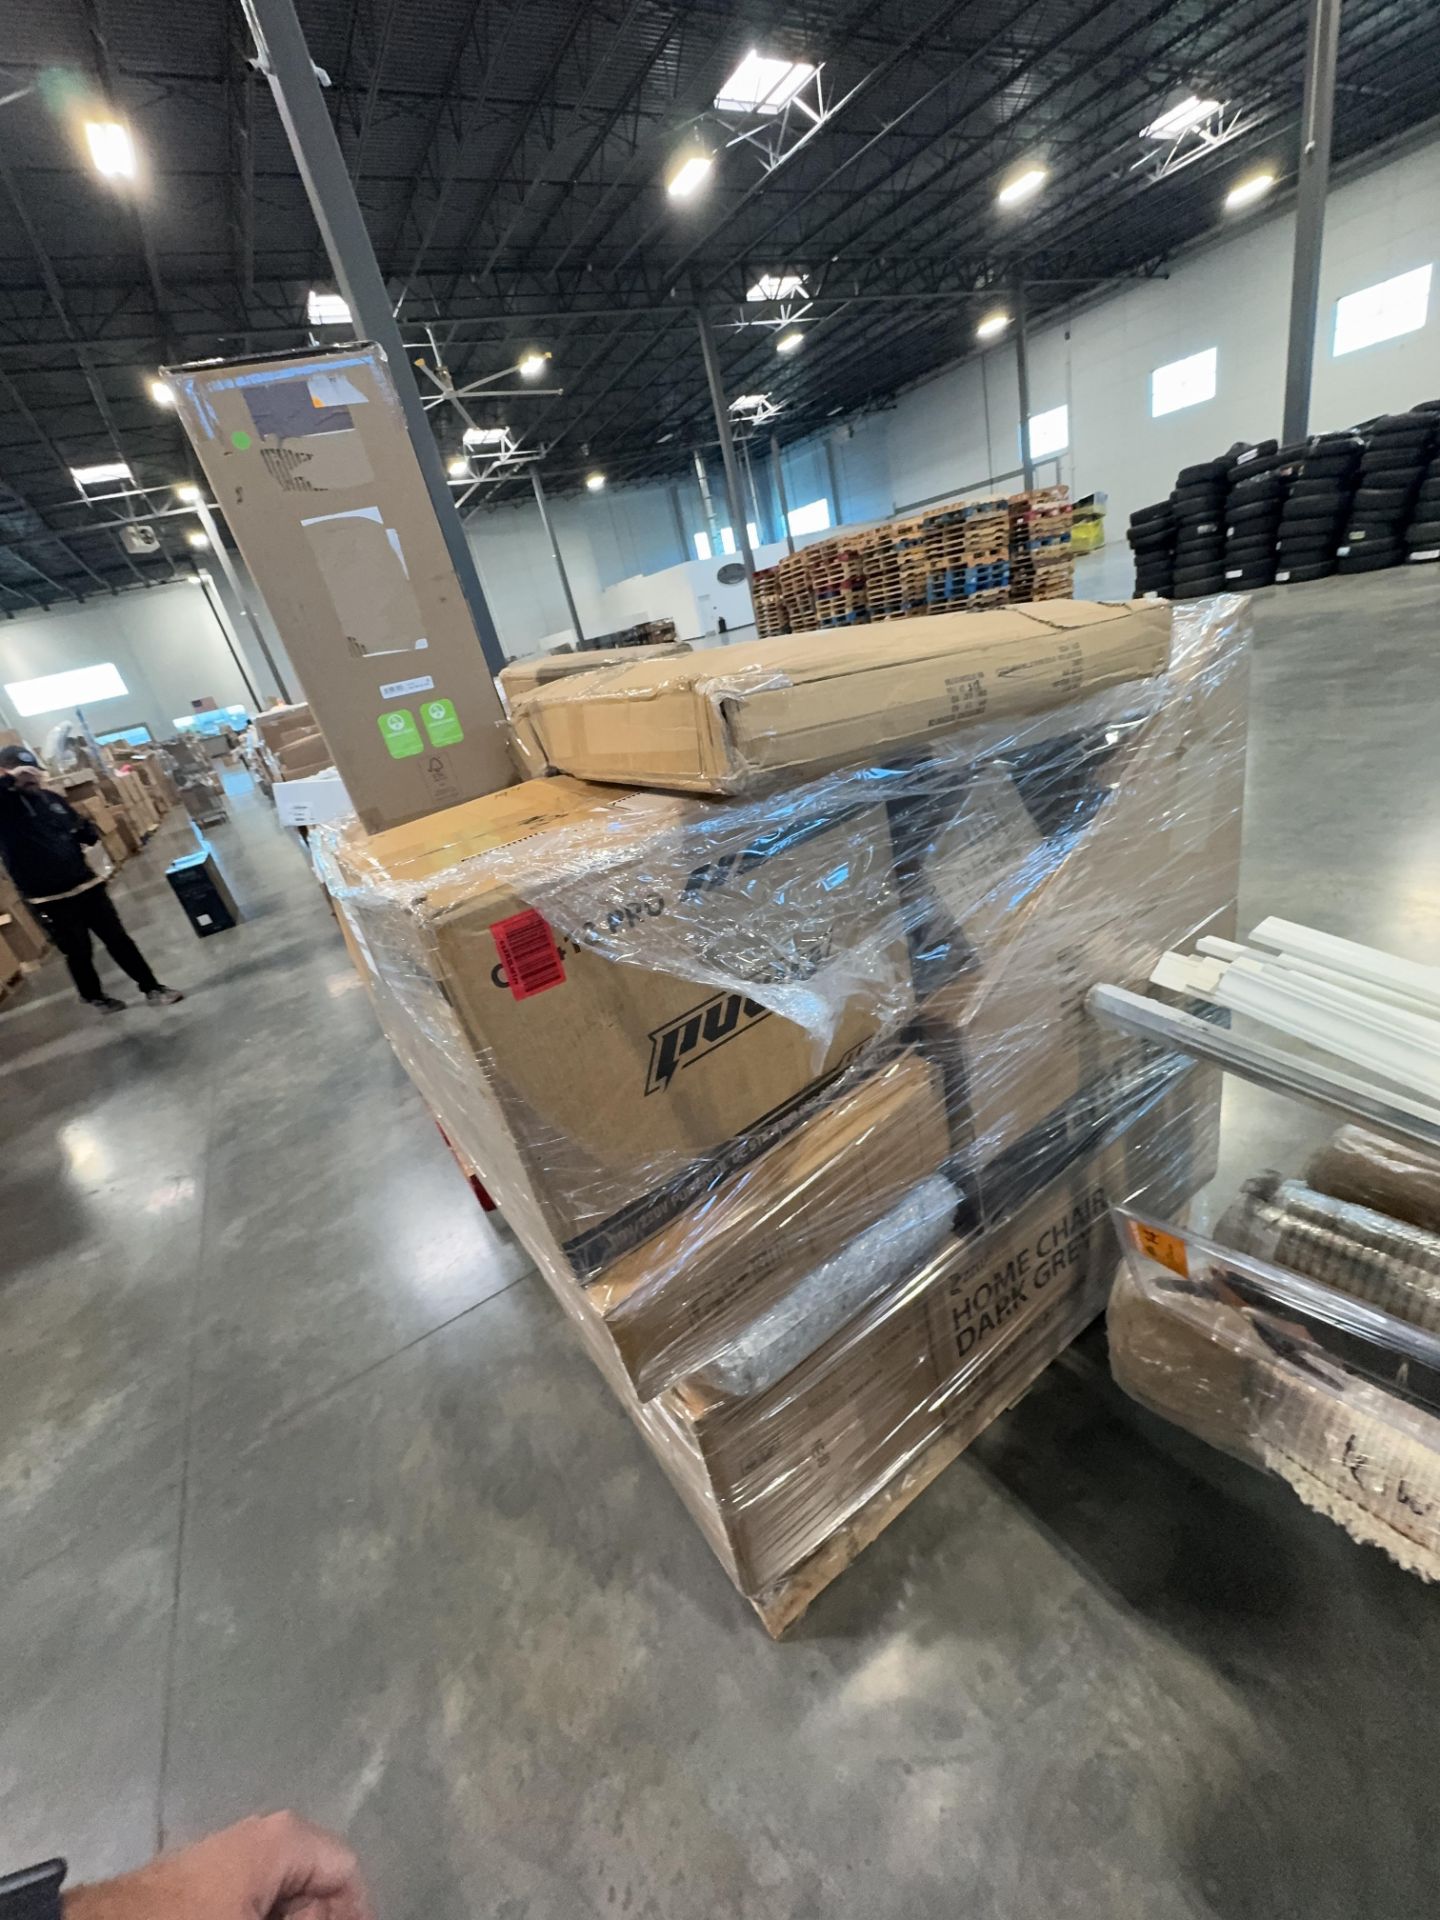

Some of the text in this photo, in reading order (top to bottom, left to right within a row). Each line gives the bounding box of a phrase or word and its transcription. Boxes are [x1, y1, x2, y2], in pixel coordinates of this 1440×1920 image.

[952, 1247, 1031, 1331] HOME
[1035, 1187, 1109, 1258] CHAIR
[955, 1279, 1028, 1357] DARK
[1033, 1226, 1094, 1289] GREY
